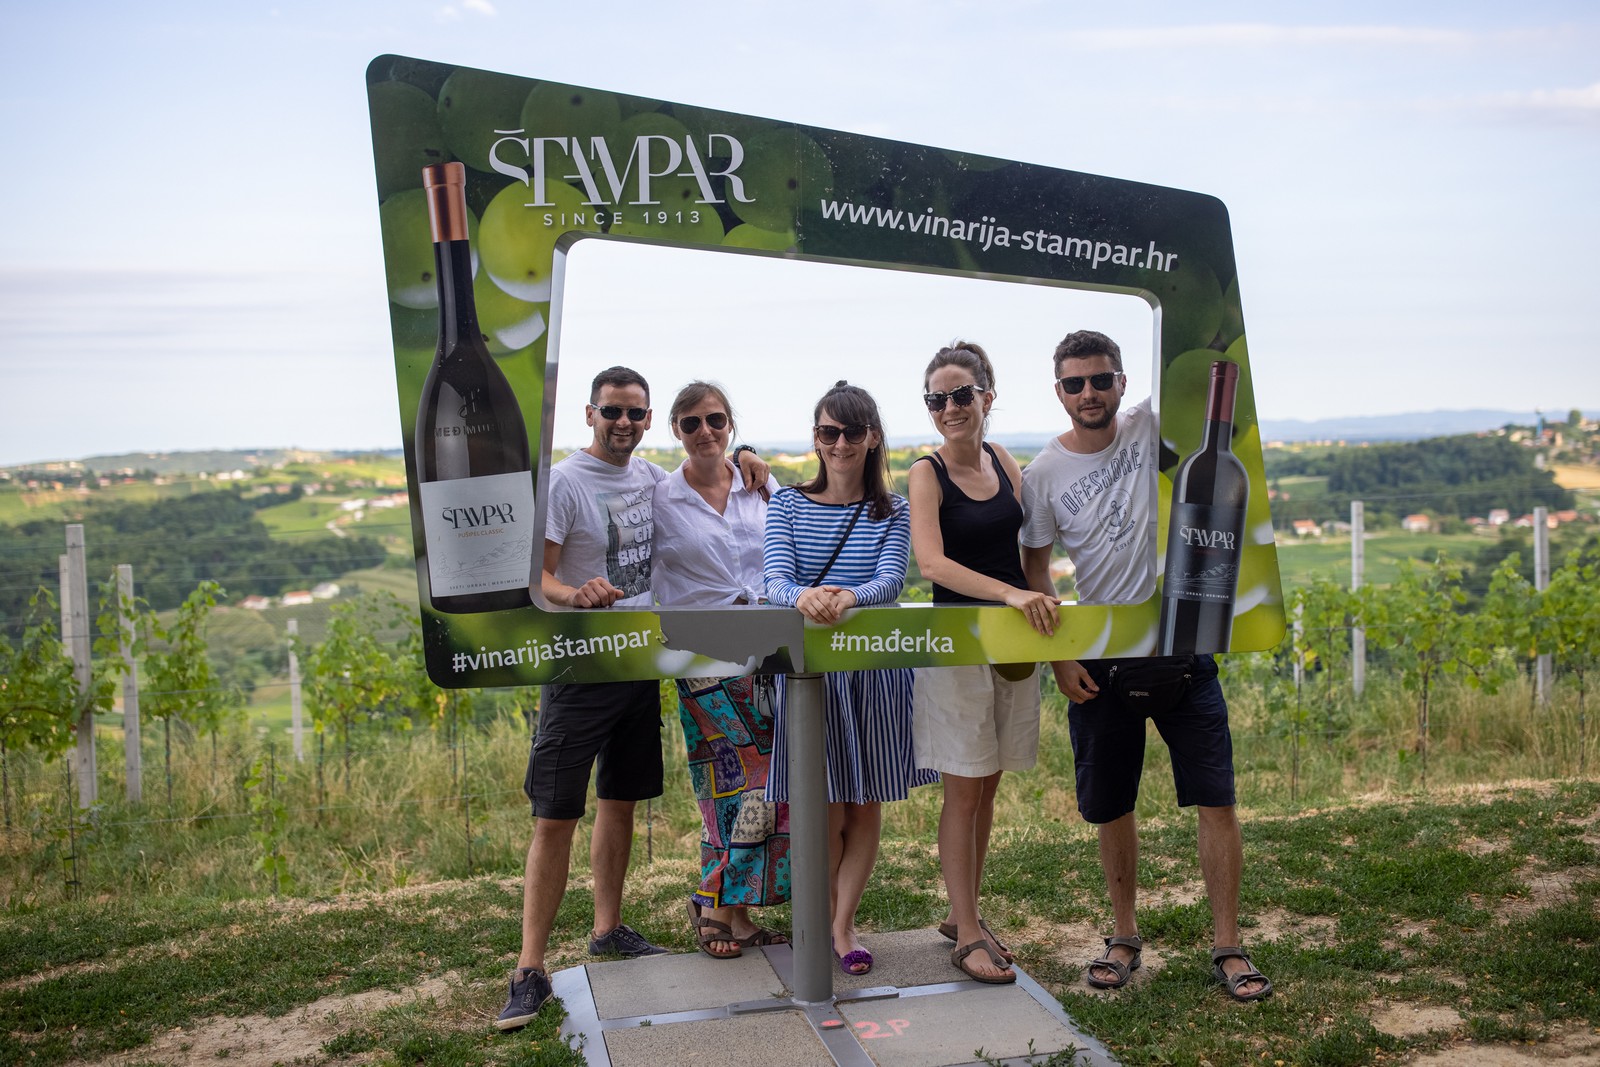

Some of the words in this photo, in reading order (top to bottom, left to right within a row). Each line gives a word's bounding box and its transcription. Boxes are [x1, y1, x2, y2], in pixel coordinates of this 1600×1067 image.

[488, 128, 757, 207] ŠTAMPAR
[543, 212, 624, 227] SINCE
[642, 210, 701, 225] 1913
[820, 198, 1178, 273] www.vinarija-stampar.hr
[1060, 441, 1142, 516] OFFSHORE
[442, 502, 517, 530] ŠTAMPAR
[480, 528, 505, 536] CLASSIC
[633, 522, 655, 544] CIT
[1179, 524, 1235, 550] ŠTAMPAR
[617, 542, 652, 567] BREA
[452, 629, 652, 673] #vinarijaštampar
[830, 628, 955, 653] #mađerka
[854, 1018, 911, 1039] 2P
